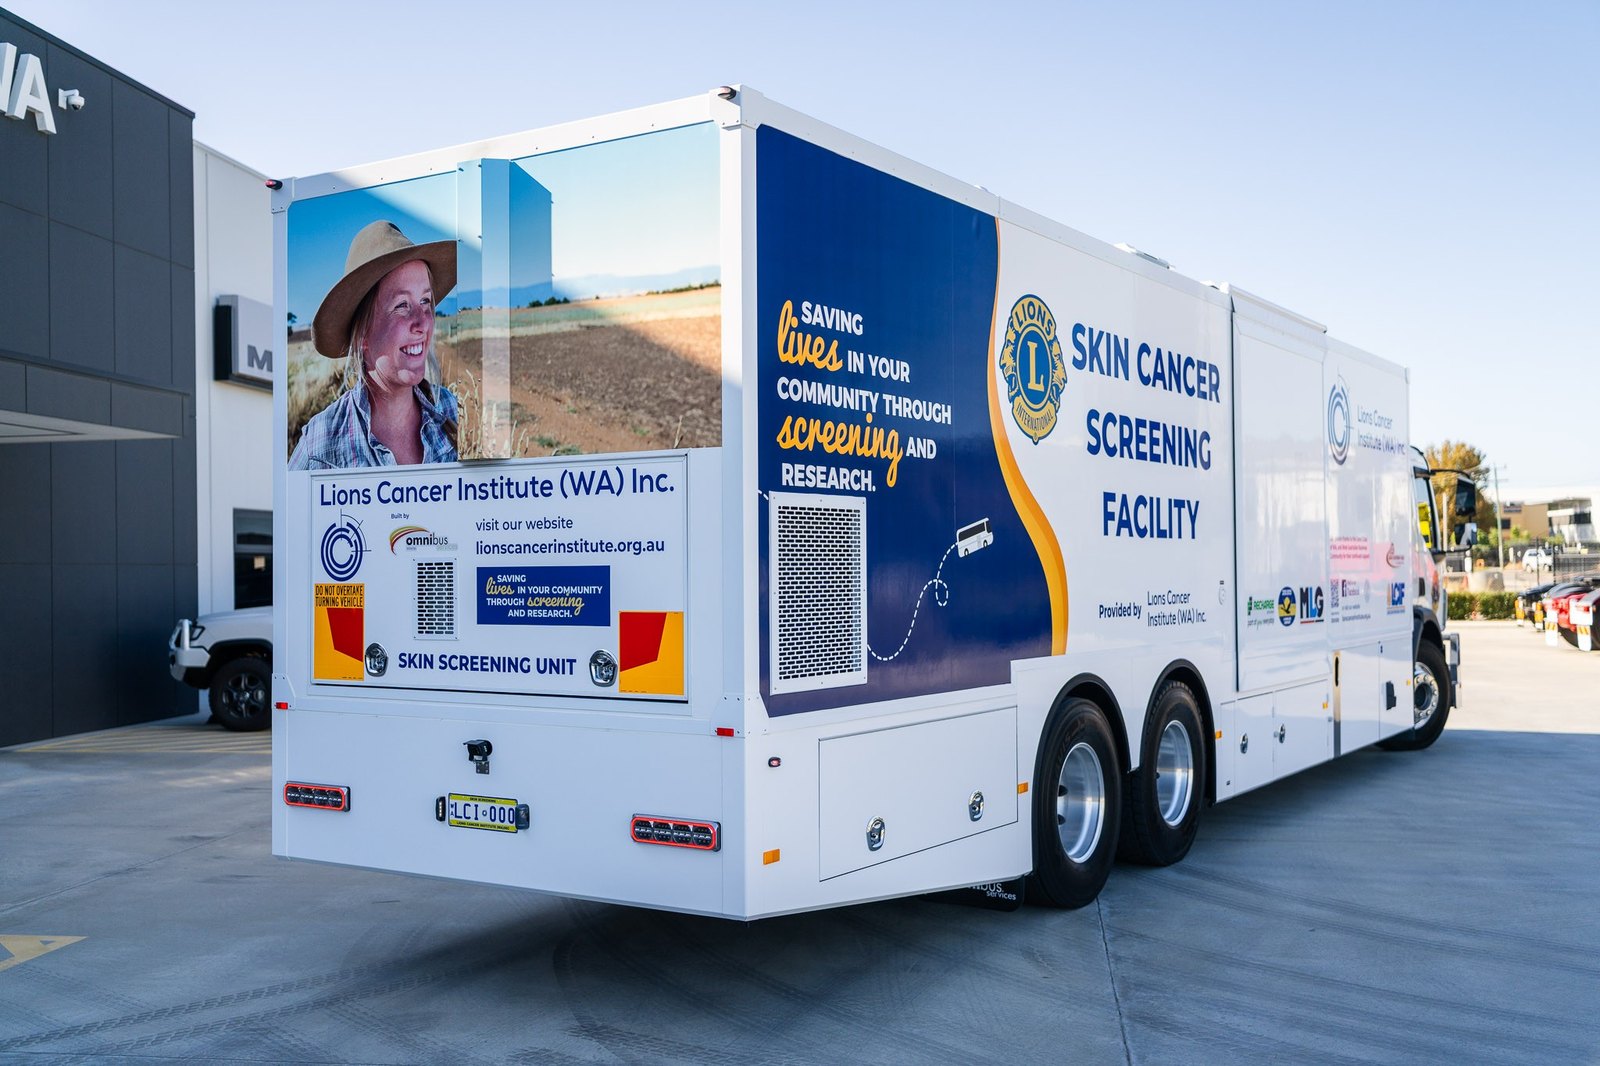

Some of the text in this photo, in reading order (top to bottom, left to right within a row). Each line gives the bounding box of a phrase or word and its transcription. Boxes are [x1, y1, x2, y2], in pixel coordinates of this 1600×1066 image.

[801, 301, 863, 335] SAVING
[1014, 299, 1054, 341] LIONS
[777, 300, 910, 383] lives IN YOUR
[1027, 341, 1045, 392] L
[1072, 323, 1221, 403] SKIN CANCER
[777, 377, 952, 425] COMMUNITY THROUGH
[1015, 401, 1055, 432] INTERNATIONAL
[776, 412, 937, 488] screening AND
[1086, 408, 1211, 471] SCREENING
[320, 466, 675, 506] Lions Cancer Institute (WA) Inc.
[781, 462, 876, 492] RESEARCH.
[475, 516, 574, 532] visit our website
[1103, 491, 1200, 540] FACILITY
[406, 532, 449, 546] omnibus
[475, 538, 665, 556] lionscancerinstitute.org.au
[486, 576, 603, 595] lives IN YOUR COMMUNITY
[497, 574, 527, 583] SAVING
[316, 585, 363, 596] DO NOT OVERTAKE
[316, 596, 363, 607] TURNING VEHICLE
[1147, 590, 1191, 606] Lions Cancer
[486, 592, 585, 616] THROUGH screening
[508, 609, 573, 618] AND RESEARCH.
[1099, 602, 1142, 620] Provided by
[1300, 586, 1324, 619] MLG
[1148, 608, 1206, 626] Institute (WA) Inc.
[398, 653, 577, 675] SKIN SCREENING UNIT
[454, 802, 478, 820] LCI
[986, 890, 1016, 900] services
